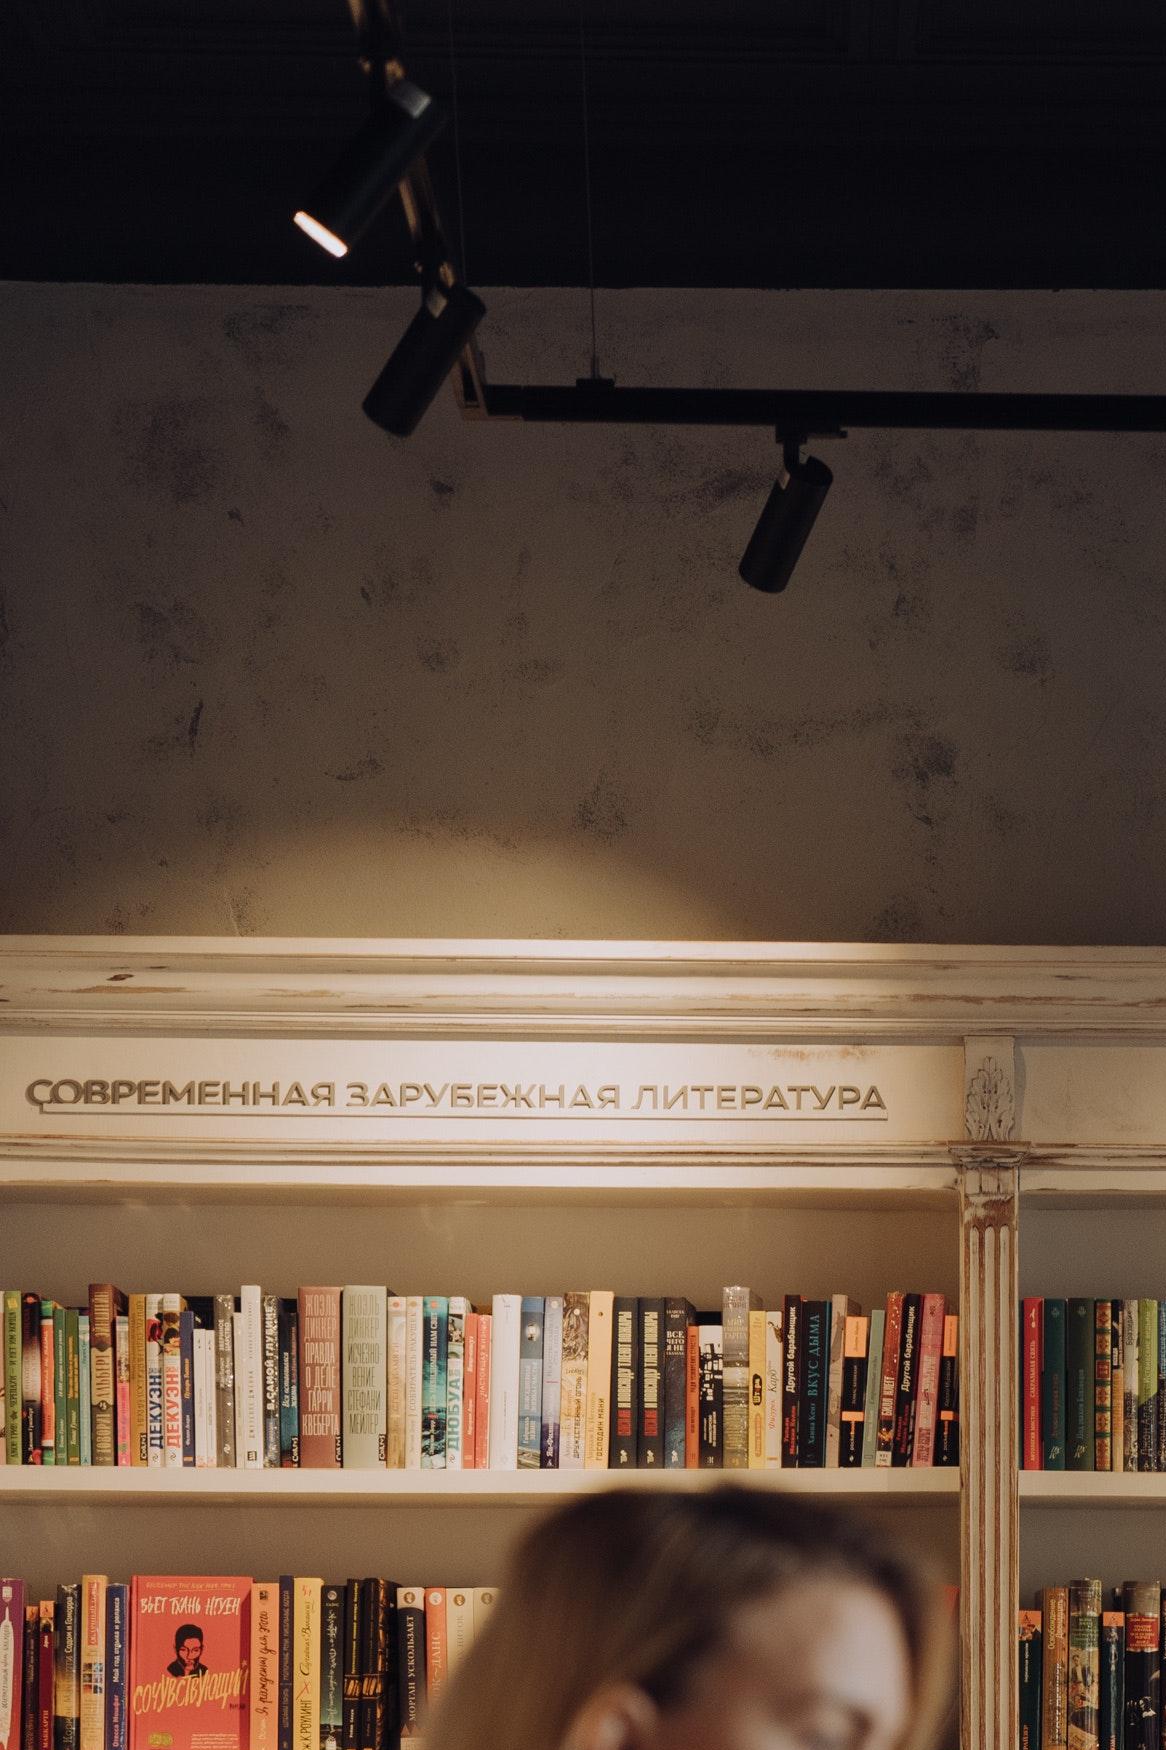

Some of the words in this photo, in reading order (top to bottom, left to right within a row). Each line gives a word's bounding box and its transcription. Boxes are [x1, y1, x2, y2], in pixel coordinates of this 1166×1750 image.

[25, 1077, 336, 1108] СОВРЕМЕННАЯ
[345, 1081, 620, 1109] ЗАРУБЕЖНАЯ
[630, 1084, 889, 1111] ЛИТЕРАТУРА
[305, 1294, 336, 1316] ЖОЭЛЬ
[787, 1307, 796, 1359] барабанщик
[808, 1314, 820, 1356] ДЫМА
[903, 1306, 915, 1358] барабанщик
[786, 1361, 795, 1392] Другой
[807, 1360, 818, 1396] ВКУС
[901, 1361, 911, 1391] Другой
[149, 1374, 163, 1449] ДЕКУЭН
[166, 1374, 181, 1448] ДЕКУЭН
[448, 1378, 460, 1451] ДЮБУА
[407, 1616, 416, 1677] УСКОЛЬЗАЕТ
